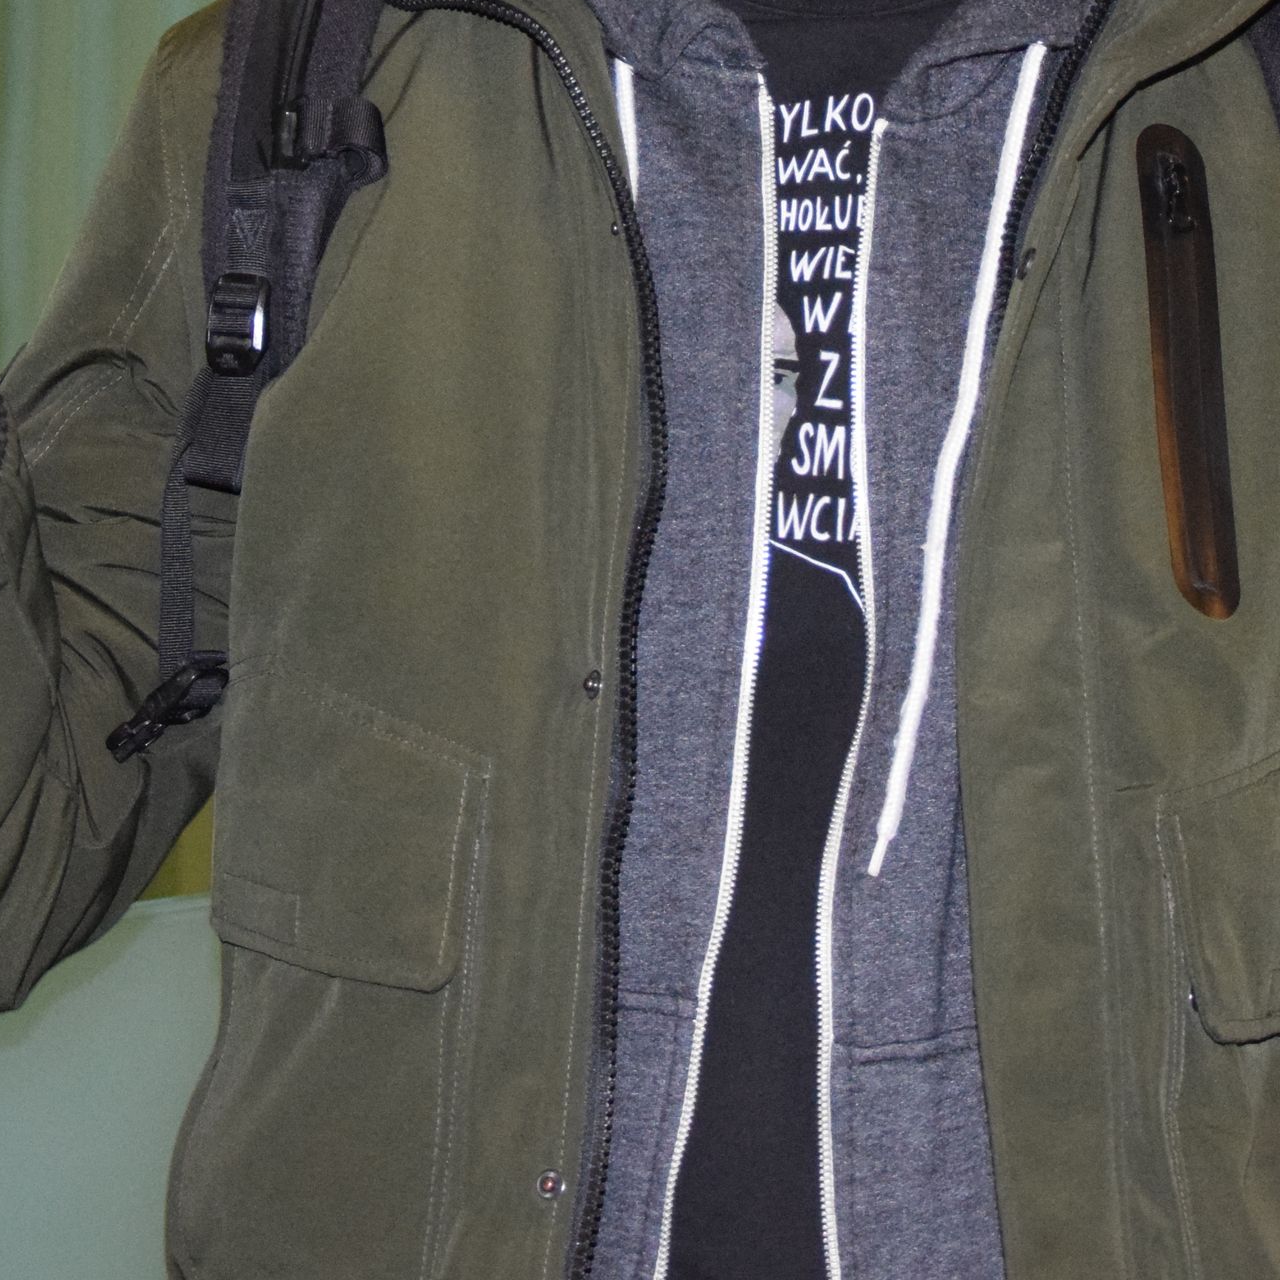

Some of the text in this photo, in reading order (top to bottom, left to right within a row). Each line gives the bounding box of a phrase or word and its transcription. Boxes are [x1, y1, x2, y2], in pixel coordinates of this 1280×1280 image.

[779, 92, 874, 143] YLKO
[778, 140, 862, 184] WAĆ,
[803, 291, 842, 333] W
[814, 349, 844, 409] Z
[791, 422, 853, 480] SM
